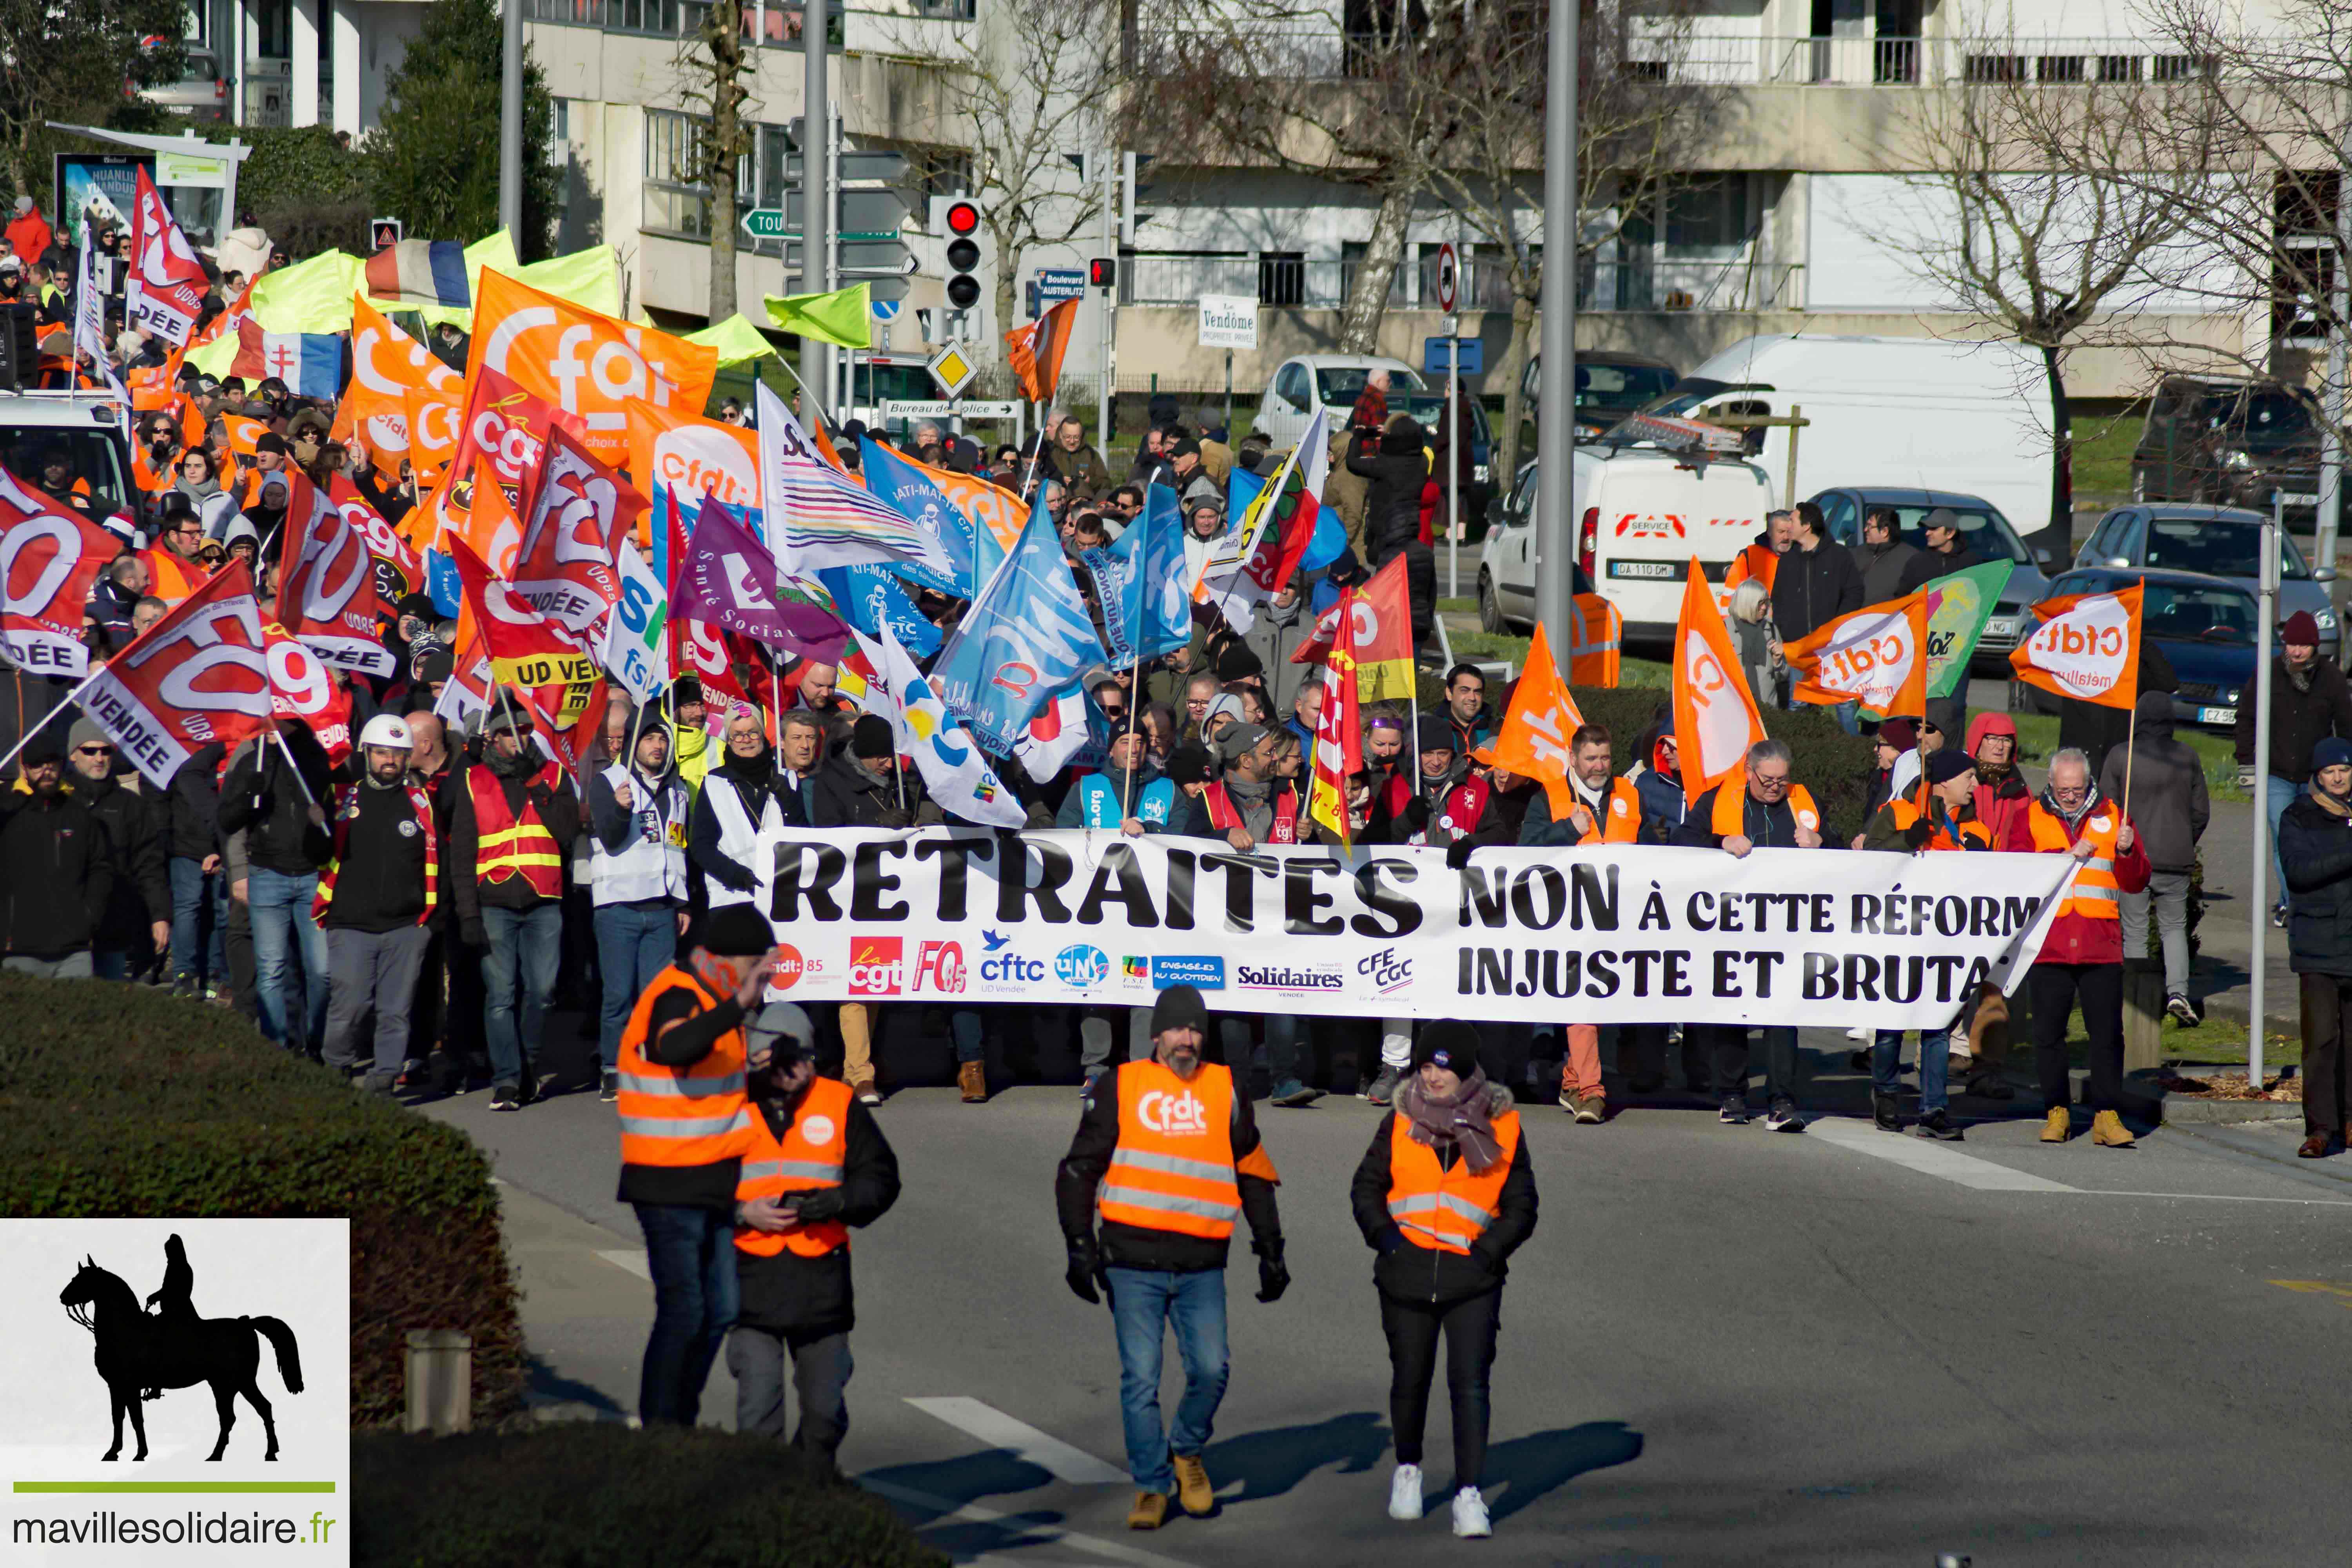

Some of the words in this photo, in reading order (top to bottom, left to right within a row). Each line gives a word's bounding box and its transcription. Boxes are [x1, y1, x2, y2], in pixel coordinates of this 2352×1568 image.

[1047, 274, 1083, 284] Boulevard
[1204, 310, 1253, 330] Vendôme
[890, 403, 932, 413] Bureau
[1632, 522, 1670, 530] SERVICE
[695, 549, 722, 606] Santé
[344, 611, 376, 637] UD85
[517, 661, 552, 686] UD
[89, 686, 171, 775] VENDÉE
[770, 837, 1424, 938] RETRAITES
[1459, 864, 1619, 931] NON
[1639, 880, 1671, 931] À
[1686, 891, 1835, 933] CETTE
[806, 959, 823, 972] 85
[848, 959, 903, 989] cgt
[980, 953, 1045, 981] cftc
[1357, 947, 1395, 975] CFE
[1376, 958, 1413, 986] CGC
[1458, 947, 1692, 998] INJUSTE
[1712, 951, 1784, 999] ET
[943, 963, 967, 993] 85
[996, 984, 1026, 993] Vendée
[1170, 973, 1221, 982] QUOTIDIEN
[1238, 966, 1343, 987] Solidaires
[1138, 1090, 1206, 1131] Cfdt
